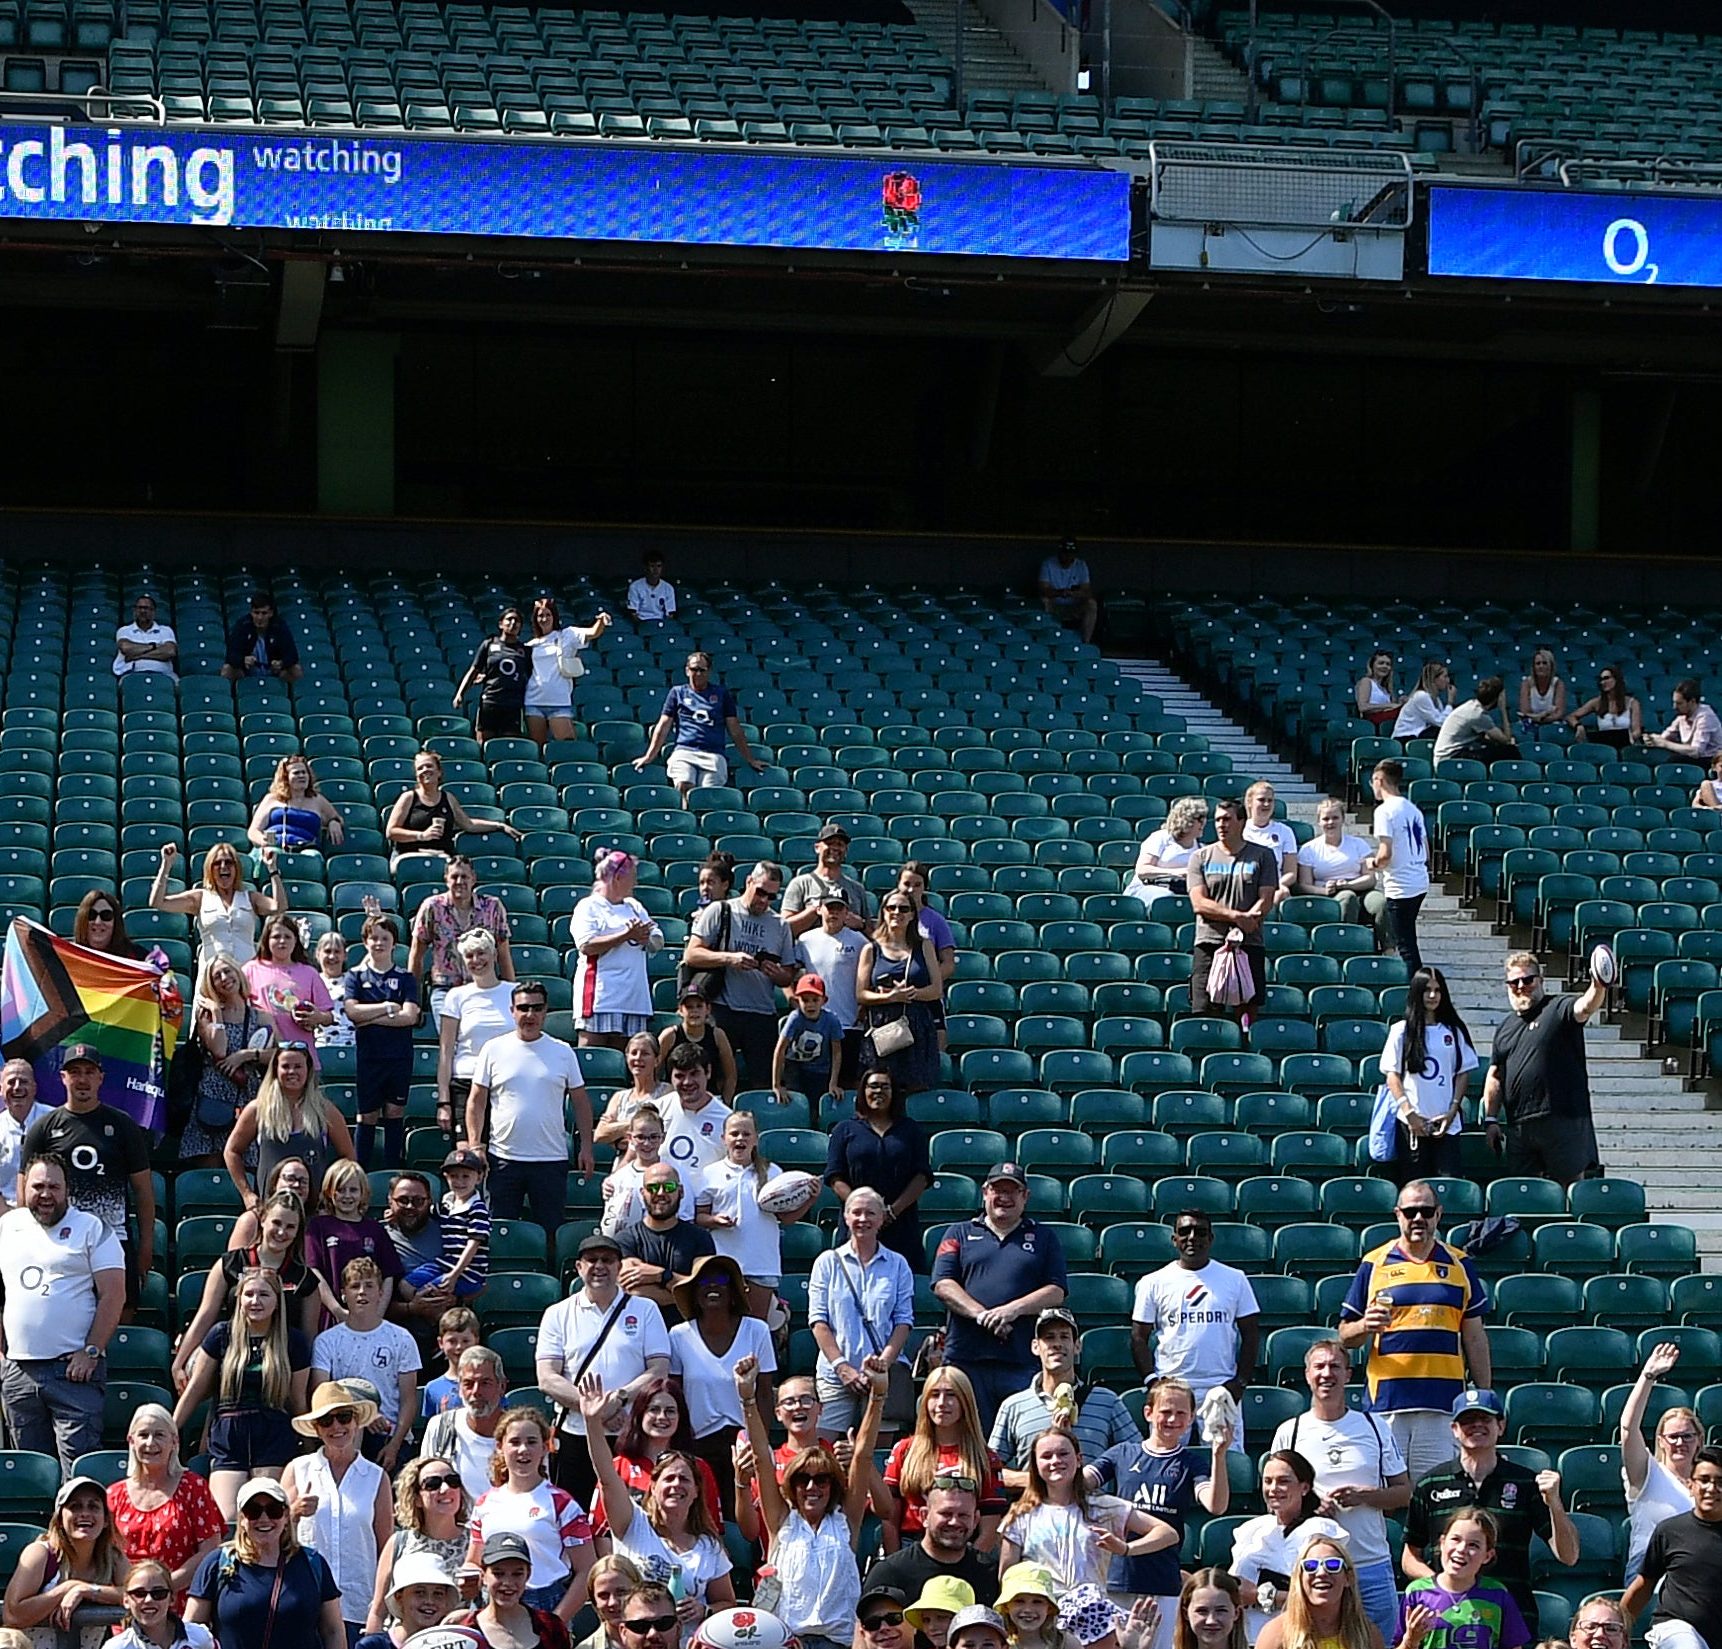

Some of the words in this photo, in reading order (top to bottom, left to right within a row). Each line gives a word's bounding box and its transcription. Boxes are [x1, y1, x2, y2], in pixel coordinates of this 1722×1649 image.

[253, 140, 402, 184] watching
[1603, 219, 1658, 284] O2
[498, 657, 519, 681] O2
[740, 920, 765, 937] HIKE
[1420, 1056, 1444, 1085] O2
[70, 1145, 105, 1175] O2
[668, 1135, 697, 1169] O2
[18, 1265, 51, 1295] O2
